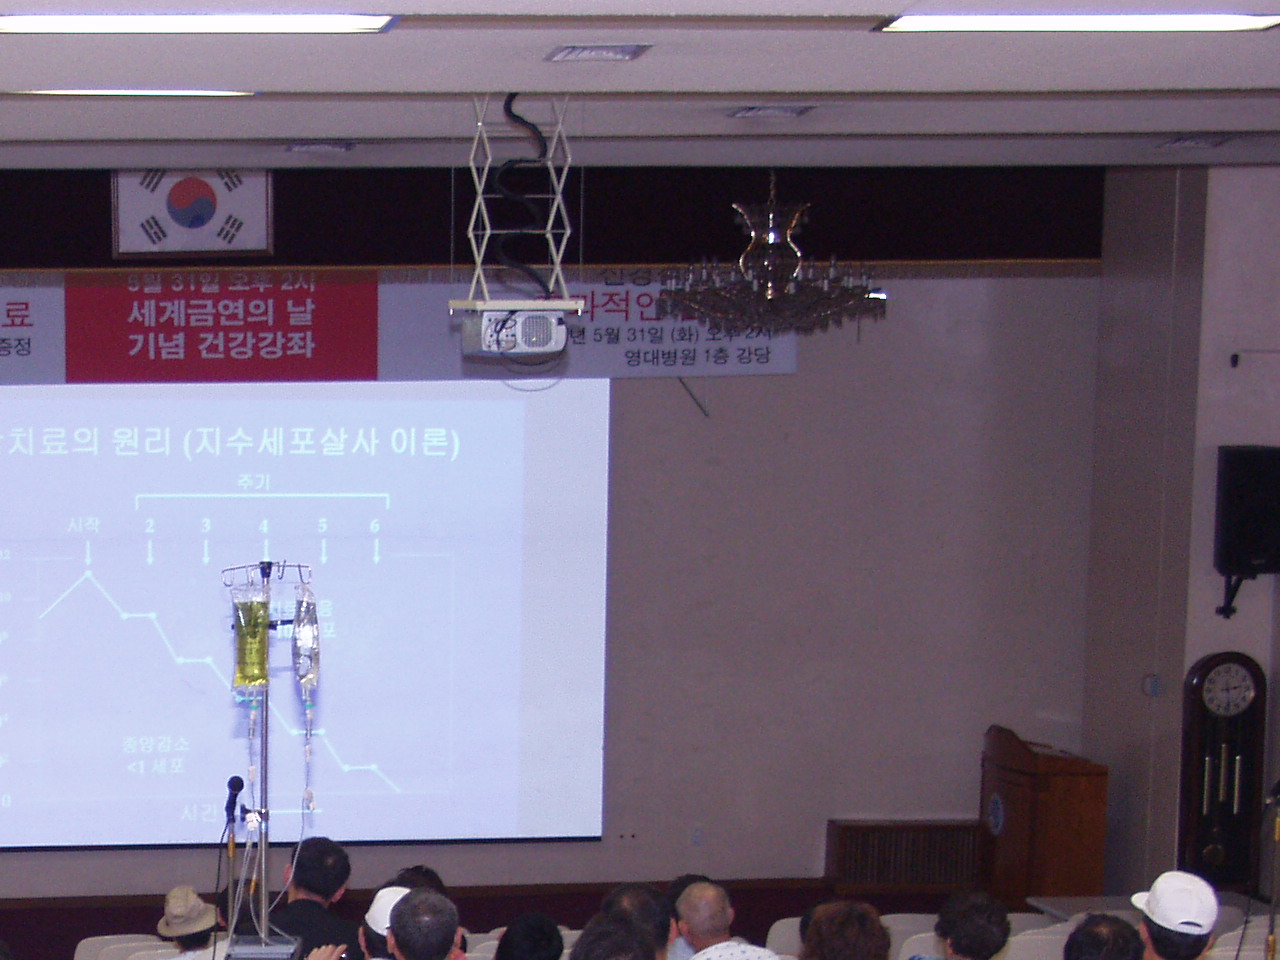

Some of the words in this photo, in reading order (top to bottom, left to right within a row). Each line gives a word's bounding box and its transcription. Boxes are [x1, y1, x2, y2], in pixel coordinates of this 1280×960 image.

[281, 271, 317, 292] 2시
[128, 298, 275, 327] 세계금연의
[287, 298, 317, 326] 날
[129, 332, 186, 361] 기념
[198, 330, 317, 360] 건강강좌
[593, 326, 620, 343] 5월
[627, 326, 664, 344] 31일
[670, 326, 700, 344] (화)
[624, 347, 697, 367] 영대병원
[705, 346, 730, 365] 1층
[736, 345, 772, 365] 강당
[112, 426, 171, 456] 원리
[183, 426, 379, 462] (지수세포살사
[391, 426, 461, 462] 이론)
[237, 473, 271, 491] 주기
[67, 516, 100, 534] 시작
[145, 518, 156, 533] 2
[201, 518, 212, 533] 3
[258, 518, 269, 534] 4
[318, 518, 328, 533] 5
[370, 518, 381, 533] 6
